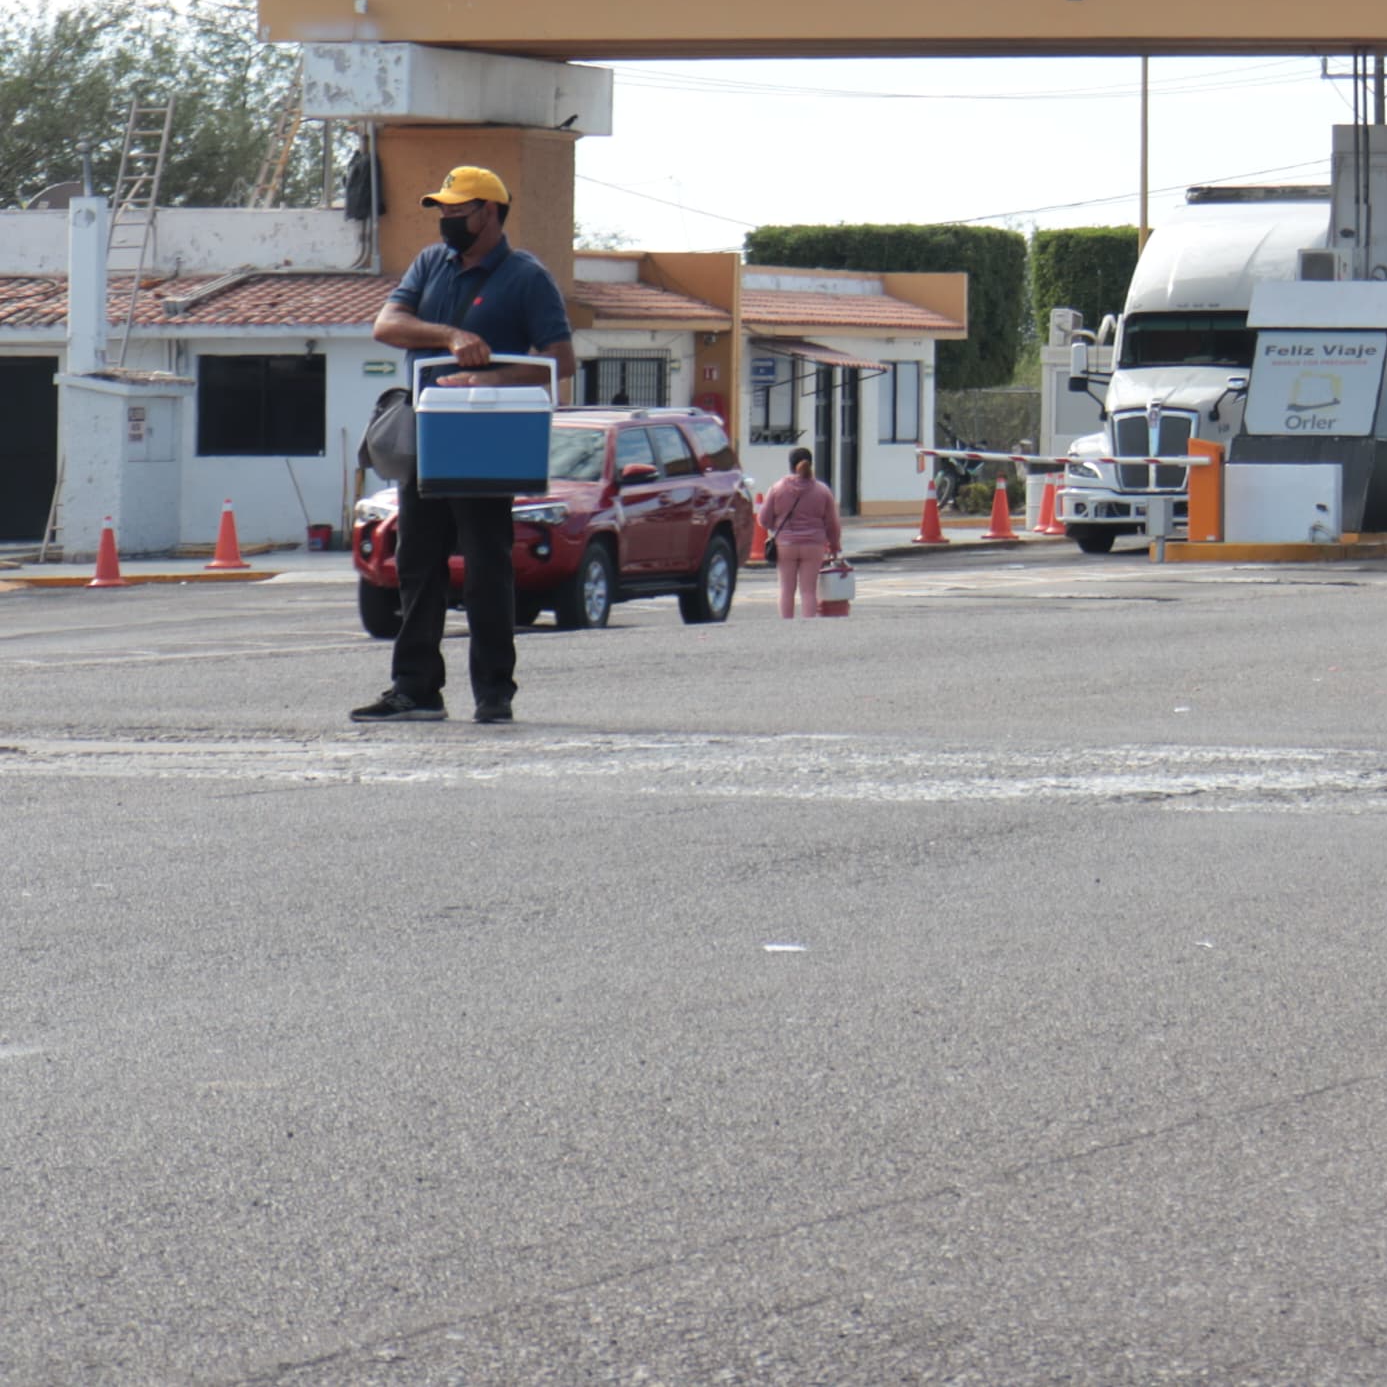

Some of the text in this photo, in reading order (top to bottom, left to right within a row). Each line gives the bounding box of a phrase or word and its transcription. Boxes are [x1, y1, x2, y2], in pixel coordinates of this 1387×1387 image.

[1264, 344, 1377, 359] Feliz Viaje
[1284, 414, 1336, 430] Orler
